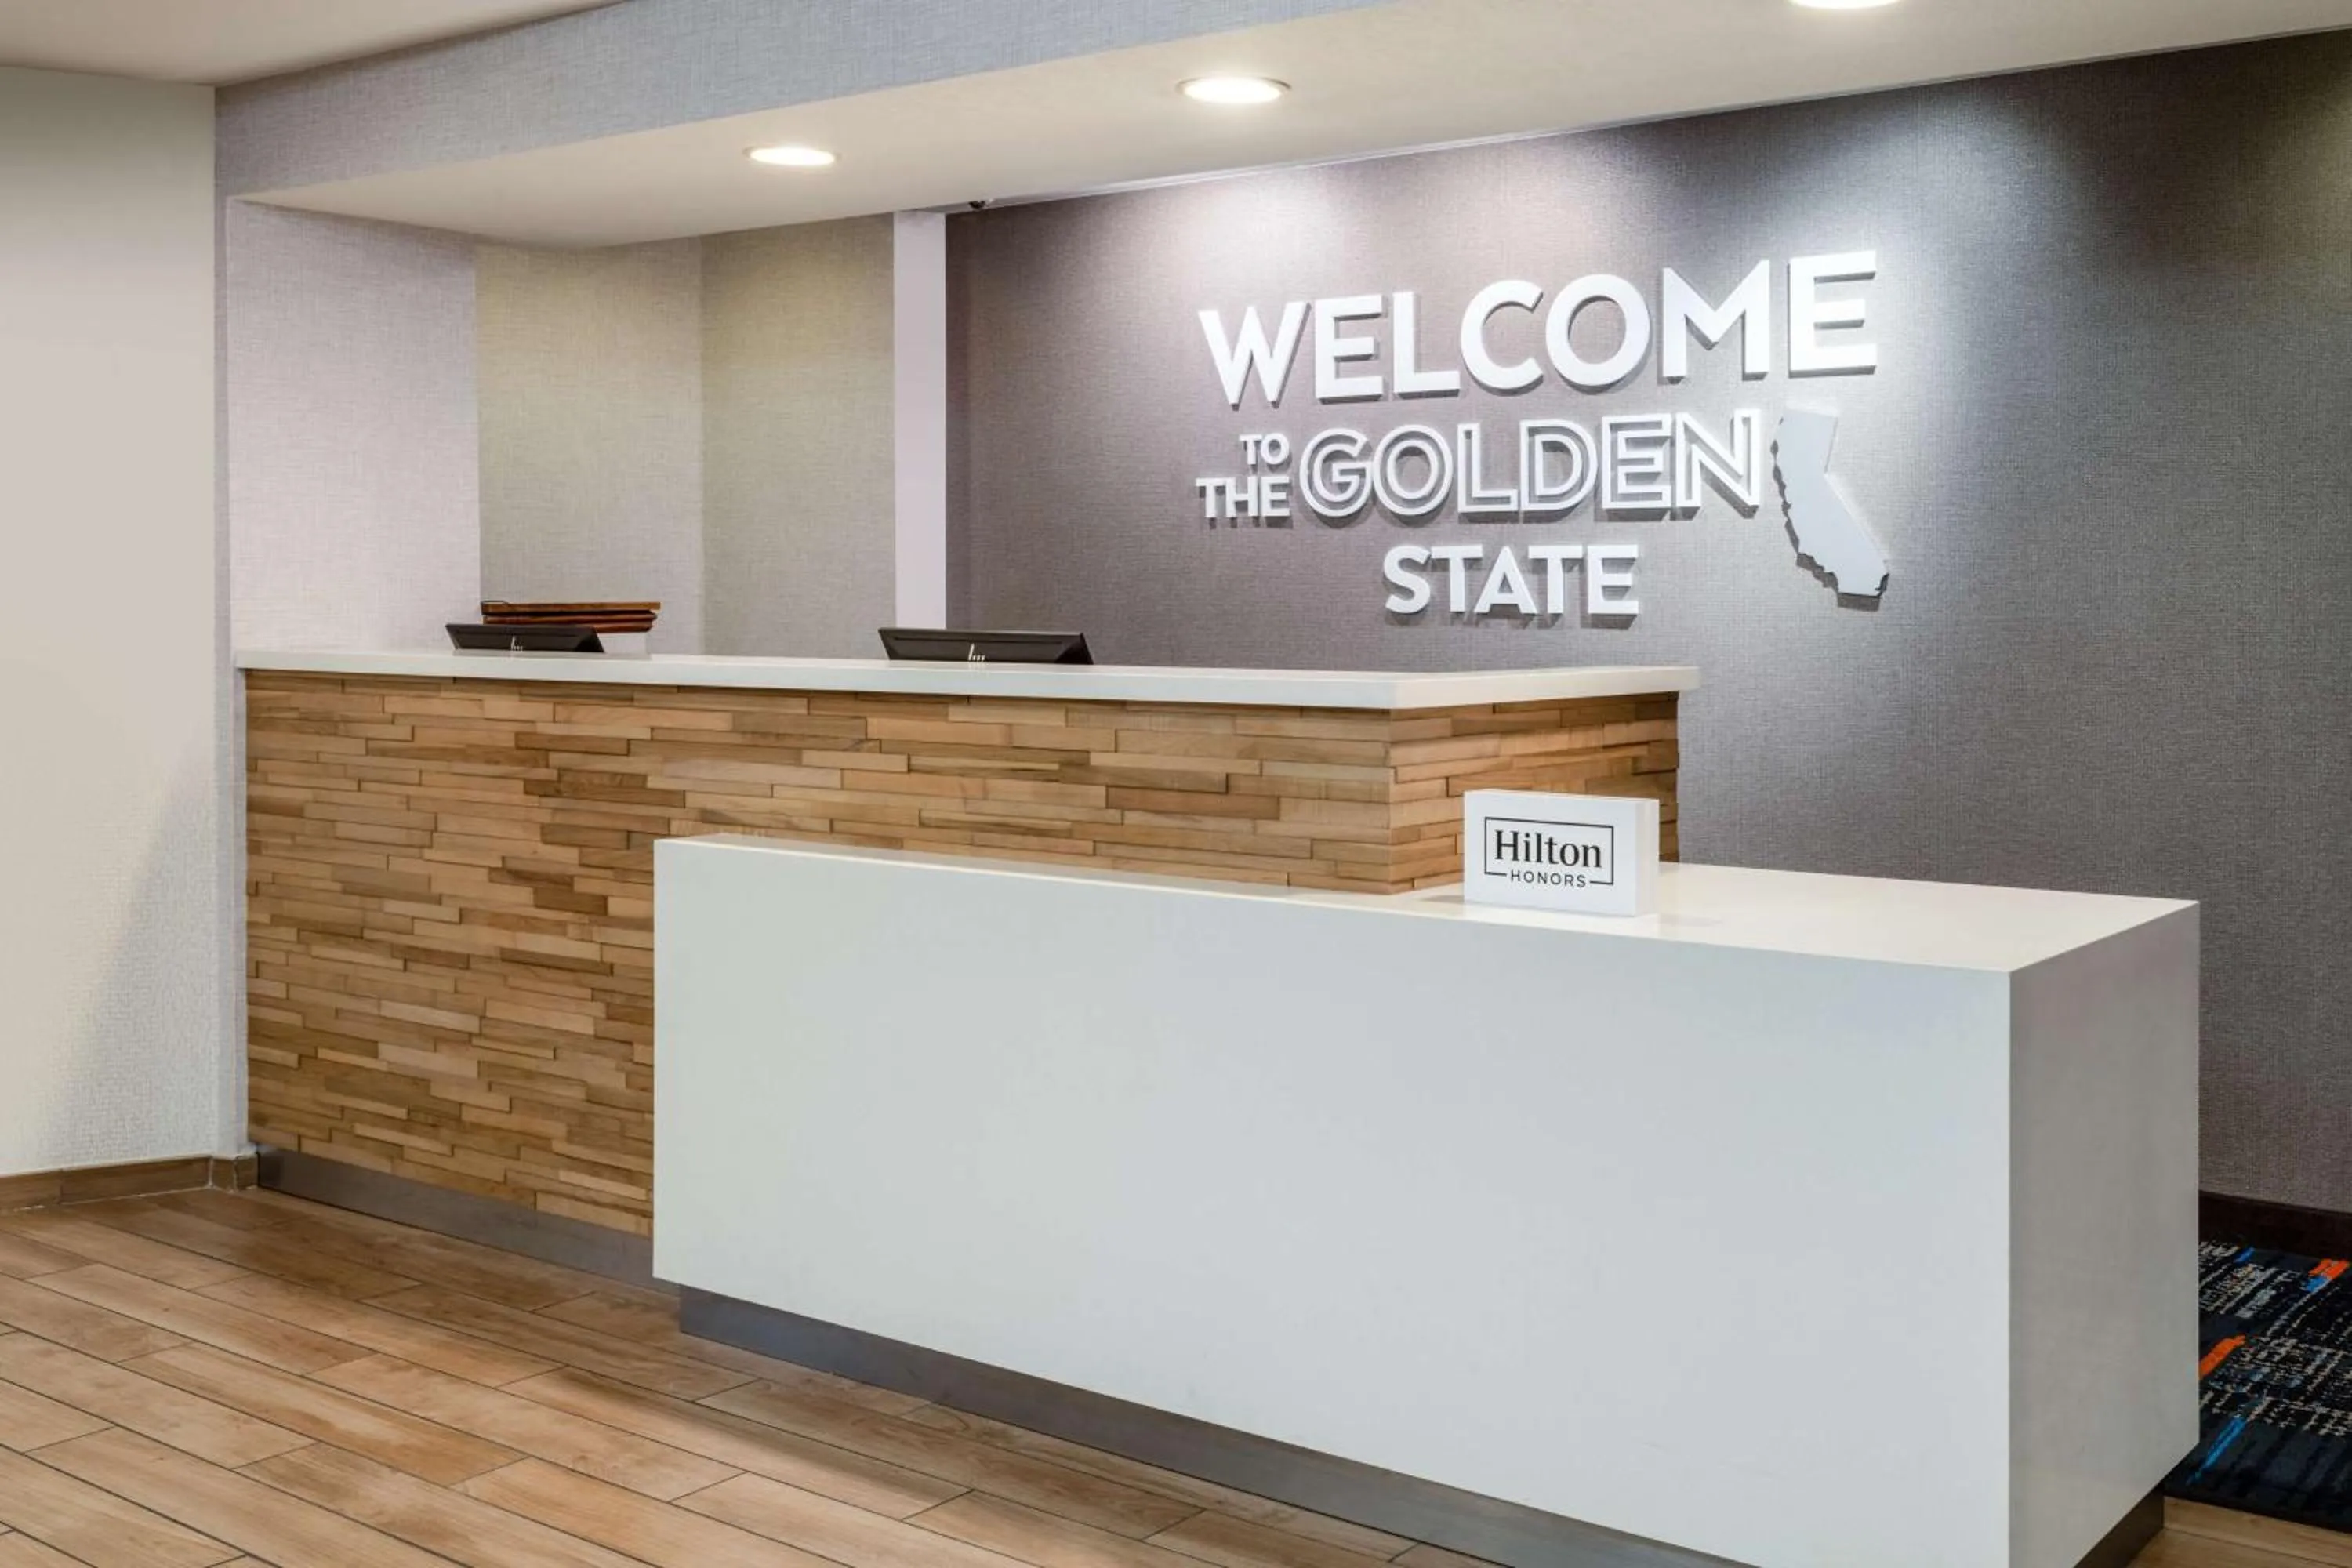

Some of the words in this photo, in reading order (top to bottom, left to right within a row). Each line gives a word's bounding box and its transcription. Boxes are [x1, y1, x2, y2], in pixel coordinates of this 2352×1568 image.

[1198, 250, 1878, 406] WELCOME
[1196, 476, 1290, 518] THE
[1300, 409, 1761, 518] GOLDEN
[1239, 433, 1290, 465] TO
[1383, 544, 1640, 615] STATE
[1495, 829, 1602, 868] Hilton
[1511, 869, 1586, 887] HONORS
